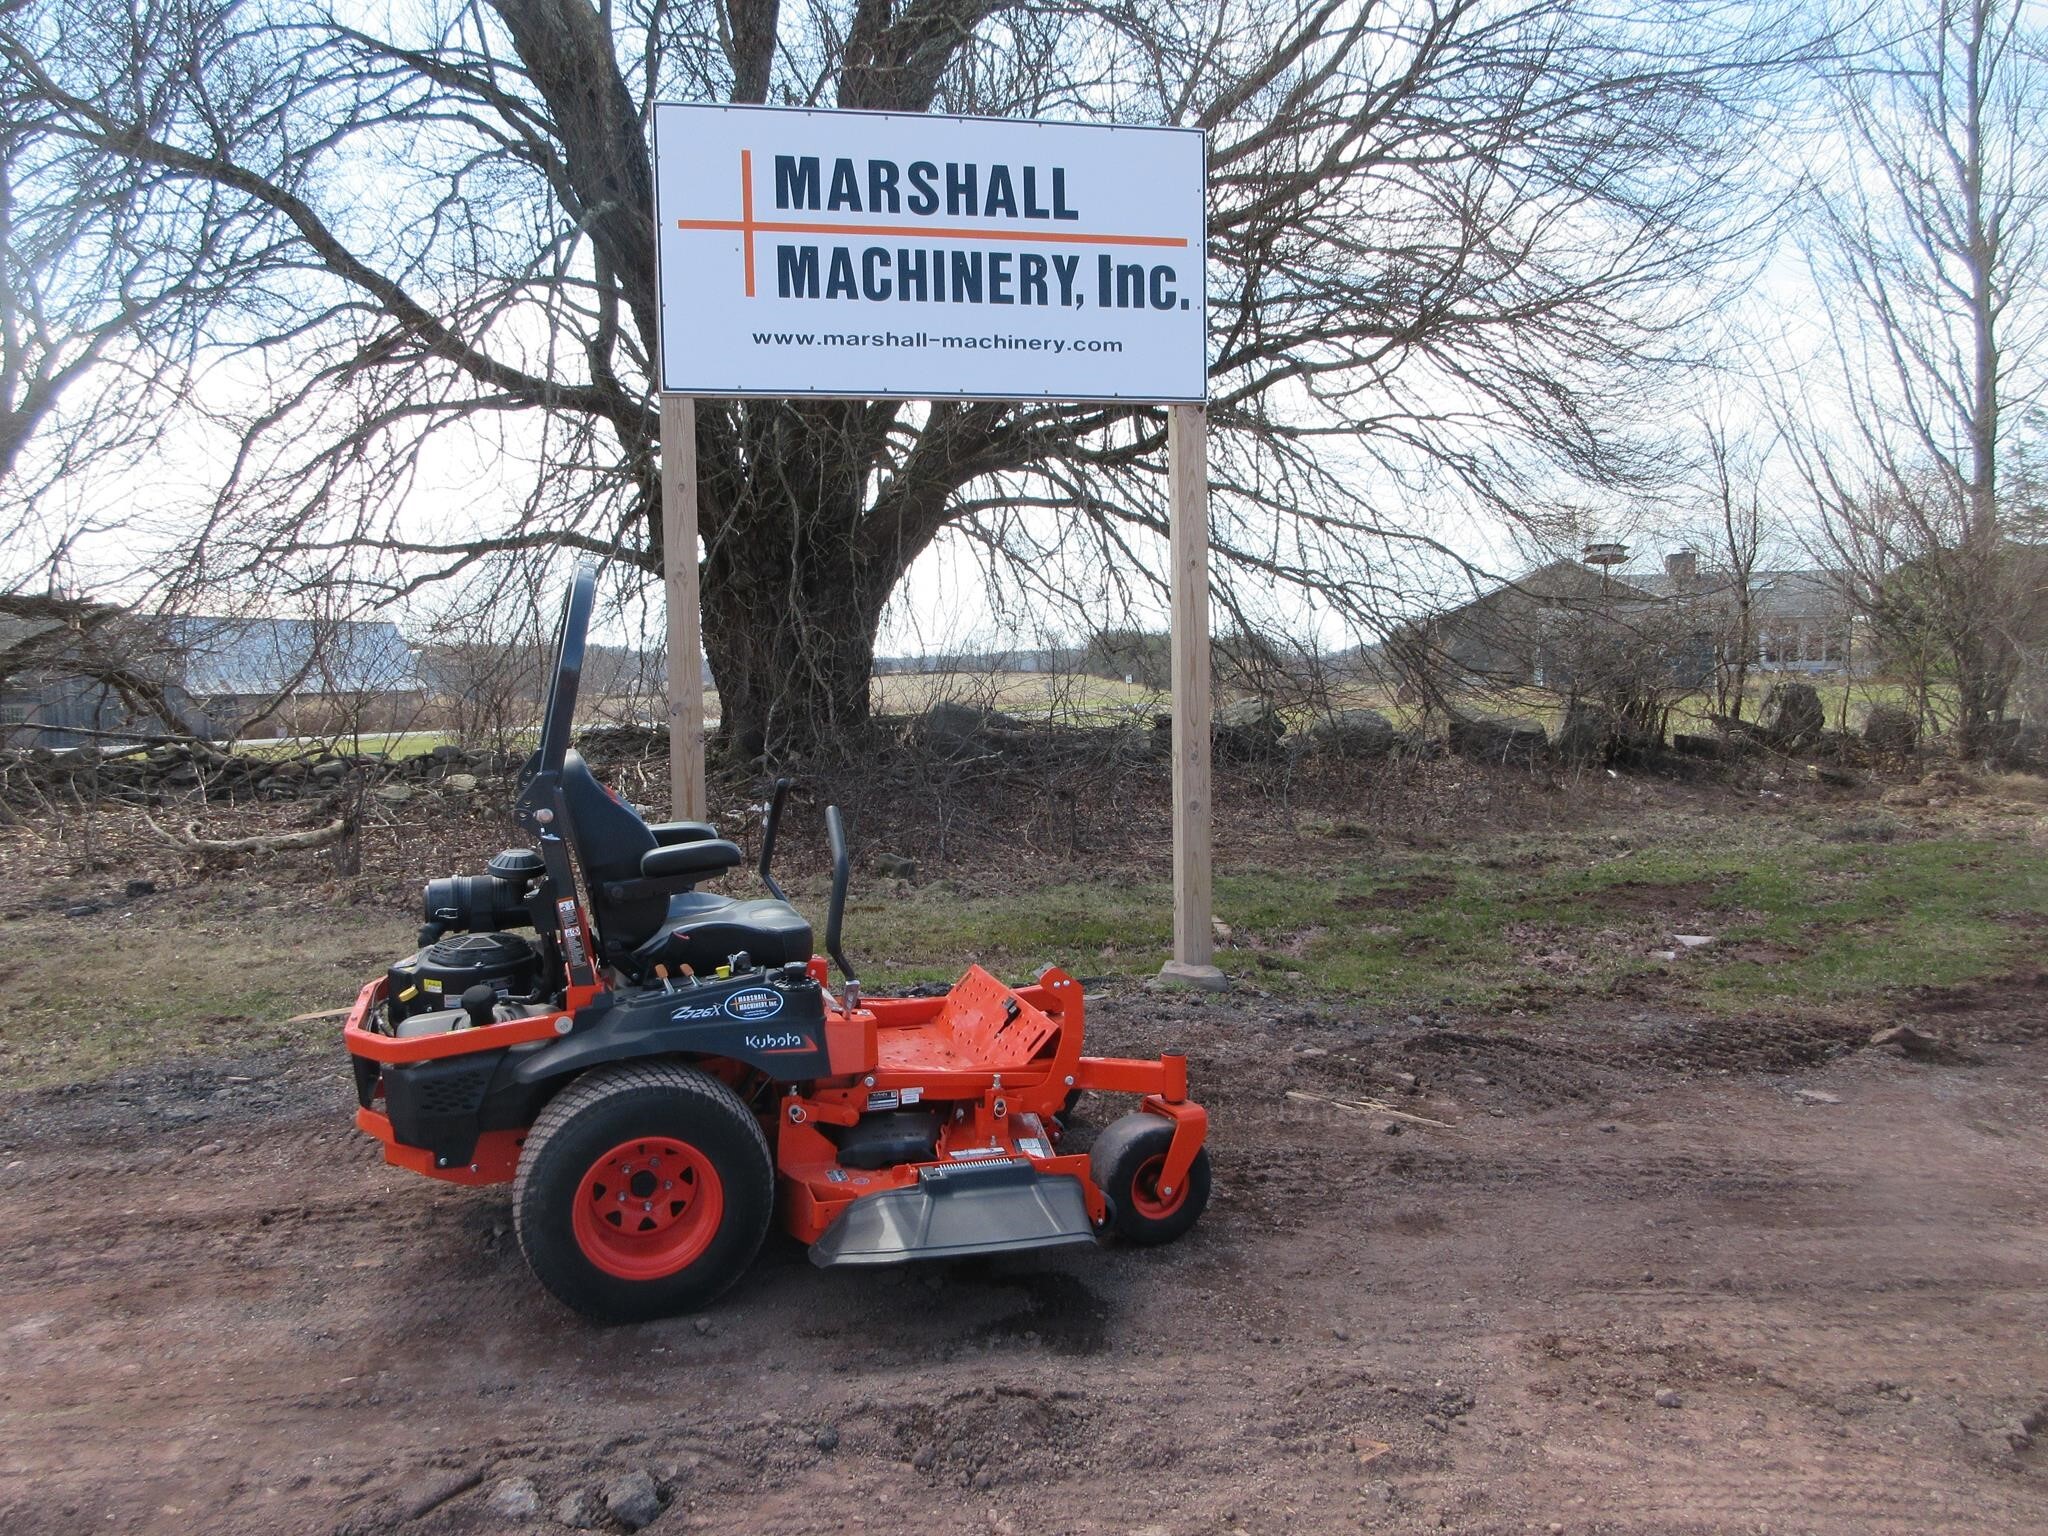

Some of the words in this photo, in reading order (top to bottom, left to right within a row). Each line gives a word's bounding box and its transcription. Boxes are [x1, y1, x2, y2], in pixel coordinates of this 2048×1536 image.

[774, 154, 1079, 221] MARSHALL
[776, 244, 1085, 311] MACHINERY,
[1098, 254, 1190, 311] Inc.
[752, 330, 1124, 353] www.marshall-machinery.com
[738, 993, 767, 1002] MARSHALL
[745, 1032, 801, 1049] Kubota
